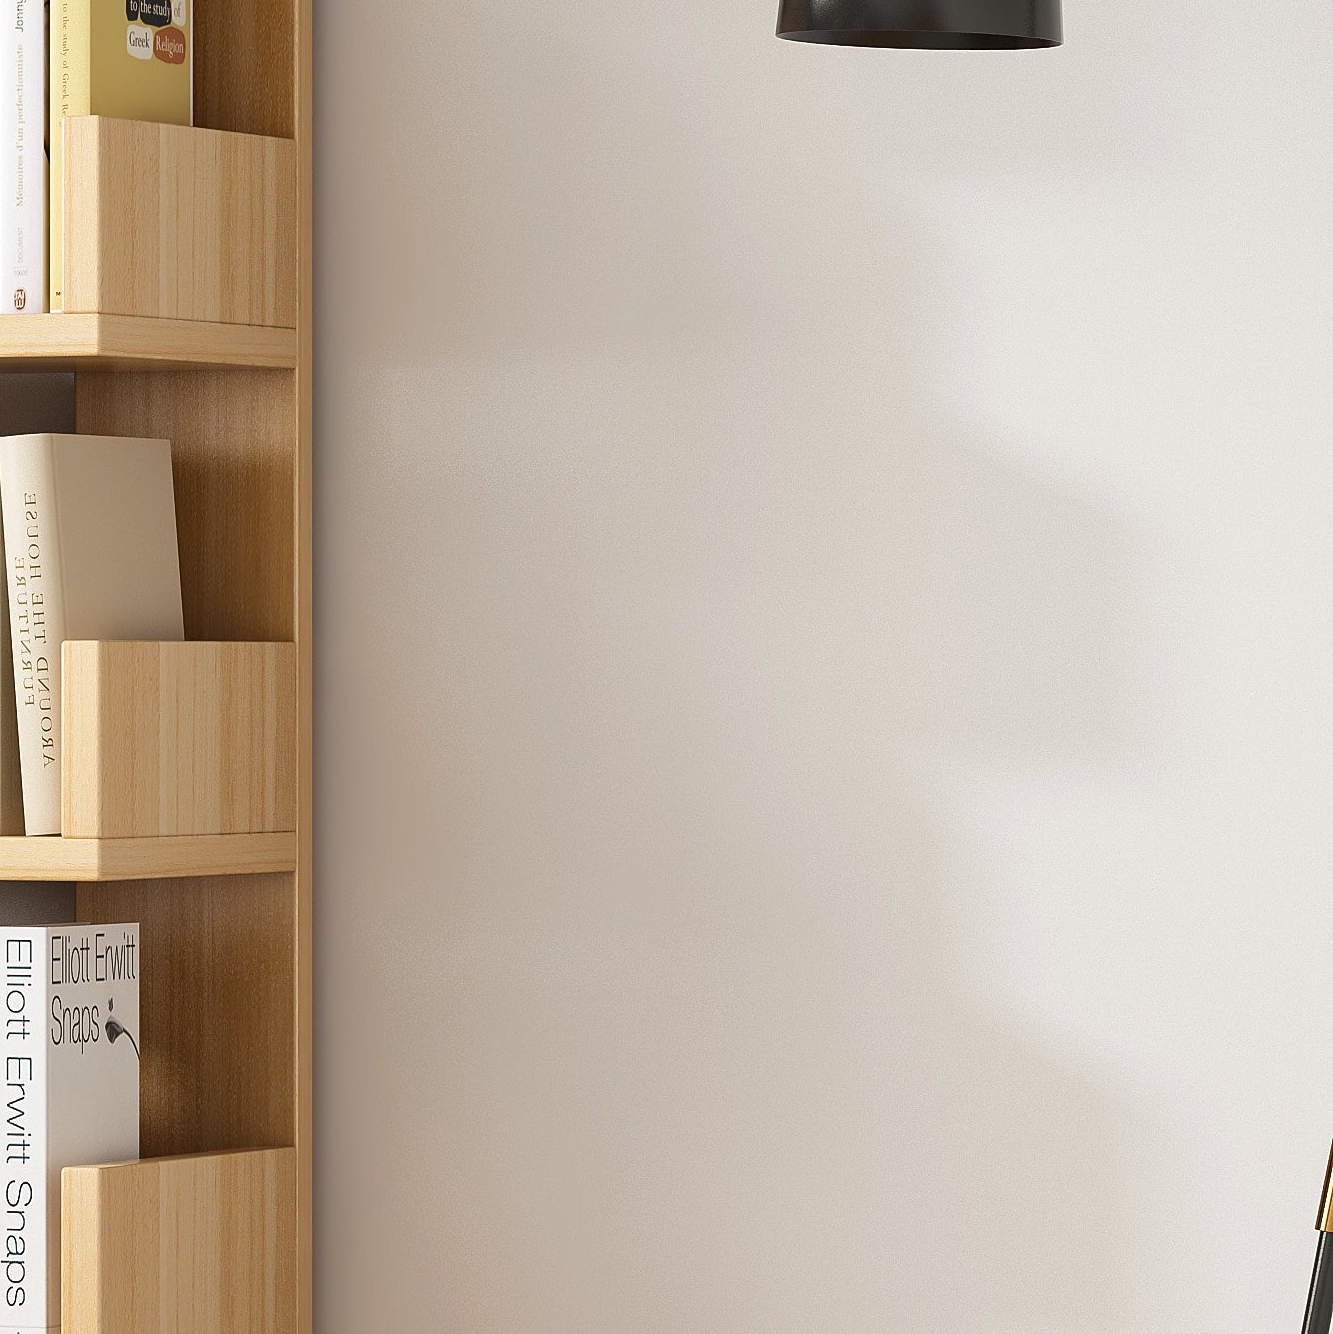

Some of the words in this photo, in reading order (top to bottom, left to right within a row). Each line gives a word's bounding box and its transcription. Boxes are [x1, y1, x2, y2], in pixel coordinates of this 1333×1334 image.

[172, 1, 182, 18] of
[127, 30, 150, 49] Greek
[156, 34, 184, 59] Religion
[51, 935, 91, 985] Elliott
[95, 931, 136, 982] Erwitt
[5, 939, 33, 1040] Elliott
[51, 995, 100, 1055] Snaps
[6, 1056, 33, 1165] Erwitt
[0, 1179, 33, 1307] Snaps
